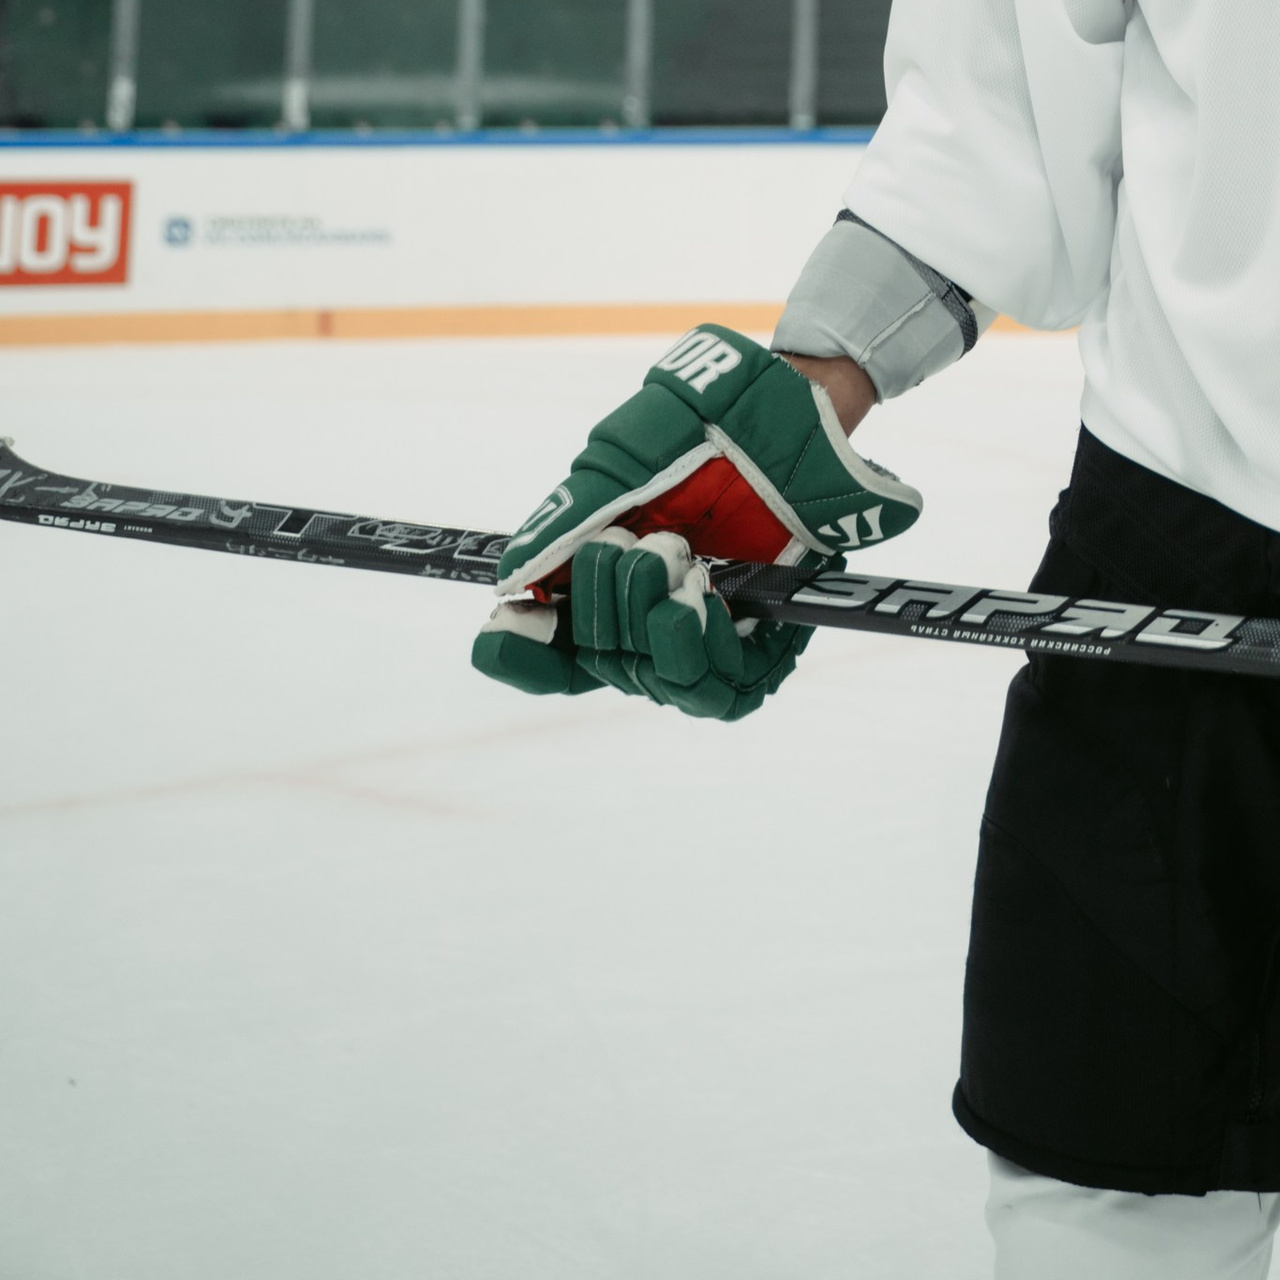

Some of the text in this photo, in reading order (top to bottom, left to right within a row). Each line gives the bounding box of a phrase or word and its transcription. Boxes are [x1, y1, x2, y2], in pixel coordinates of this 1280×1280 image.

[790, 572, 1246, 650] ЗАРЯД
[910, 624, 1111, 656] РОССИЙСКИЙ ХОККЕЙНЫЙ СТИЛЬ
